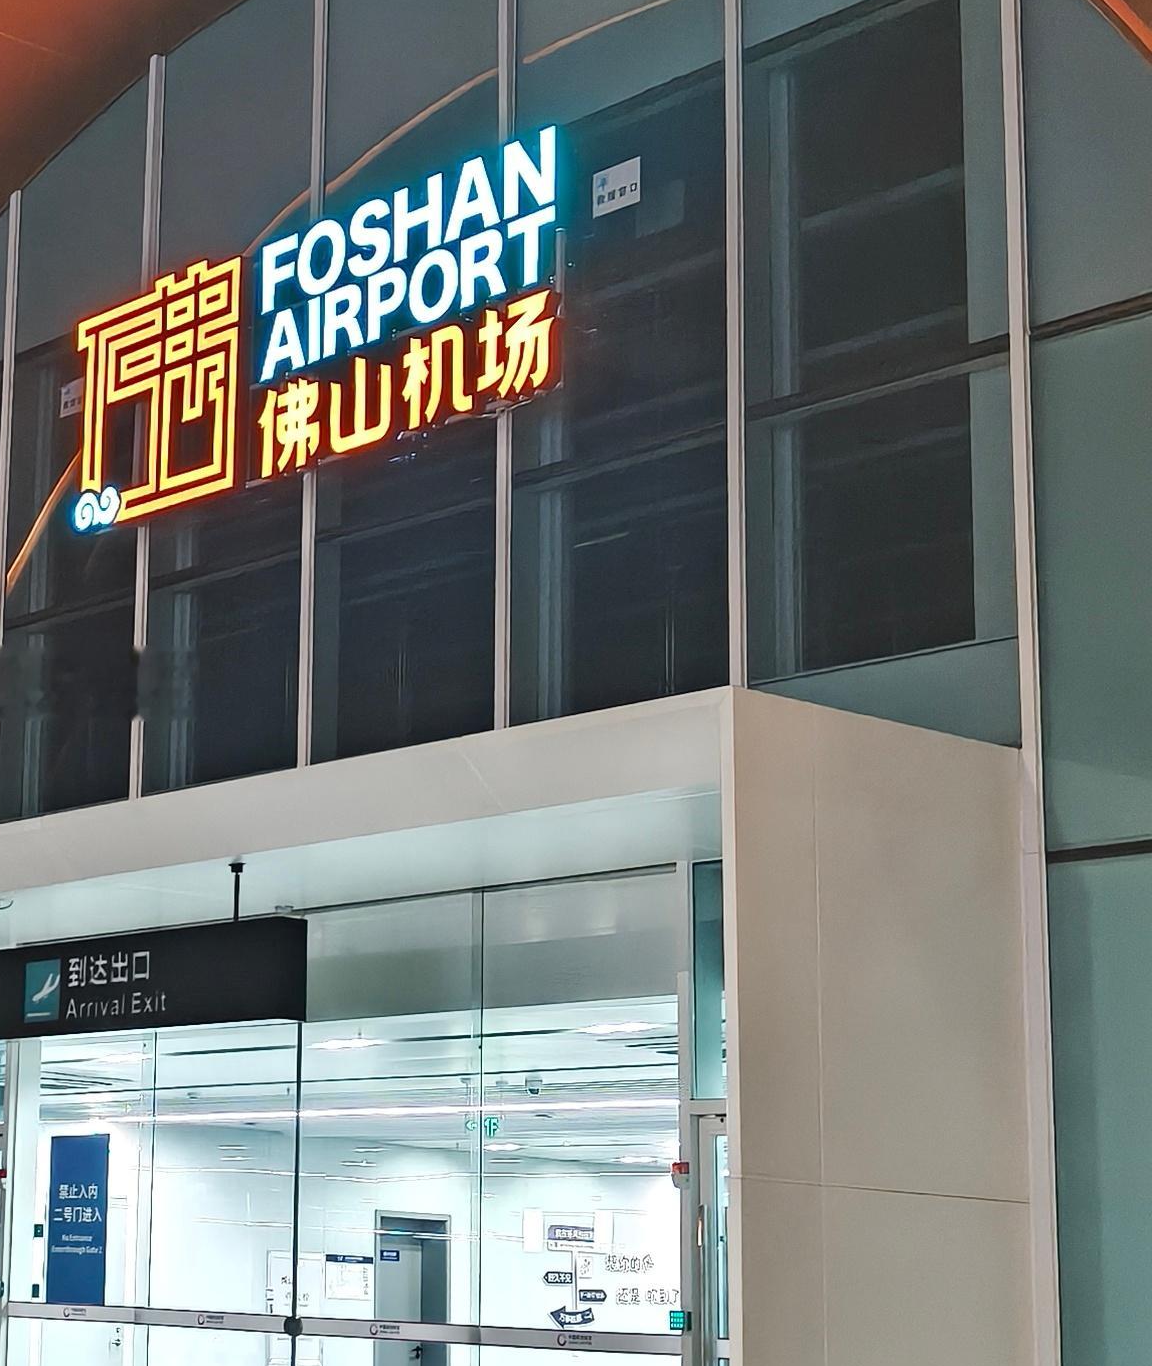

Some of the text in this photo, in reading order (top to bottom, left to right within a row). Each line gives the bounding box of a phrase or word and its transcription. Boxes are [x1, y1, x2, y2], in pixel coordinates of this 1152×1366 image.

[261, 125, 557, 315] FOSHAN
[259, 206, 556, 382] AIRPORT
[257, 289, 556, 480] 佛山机场
[67, 950, 150, 988] 到达出口
[65, 991, 167, 1020] Arrival Exit
[58, 1183, 99, 1200] 禁止入内
[53, 1206, 102, 1223] 二号门进入
